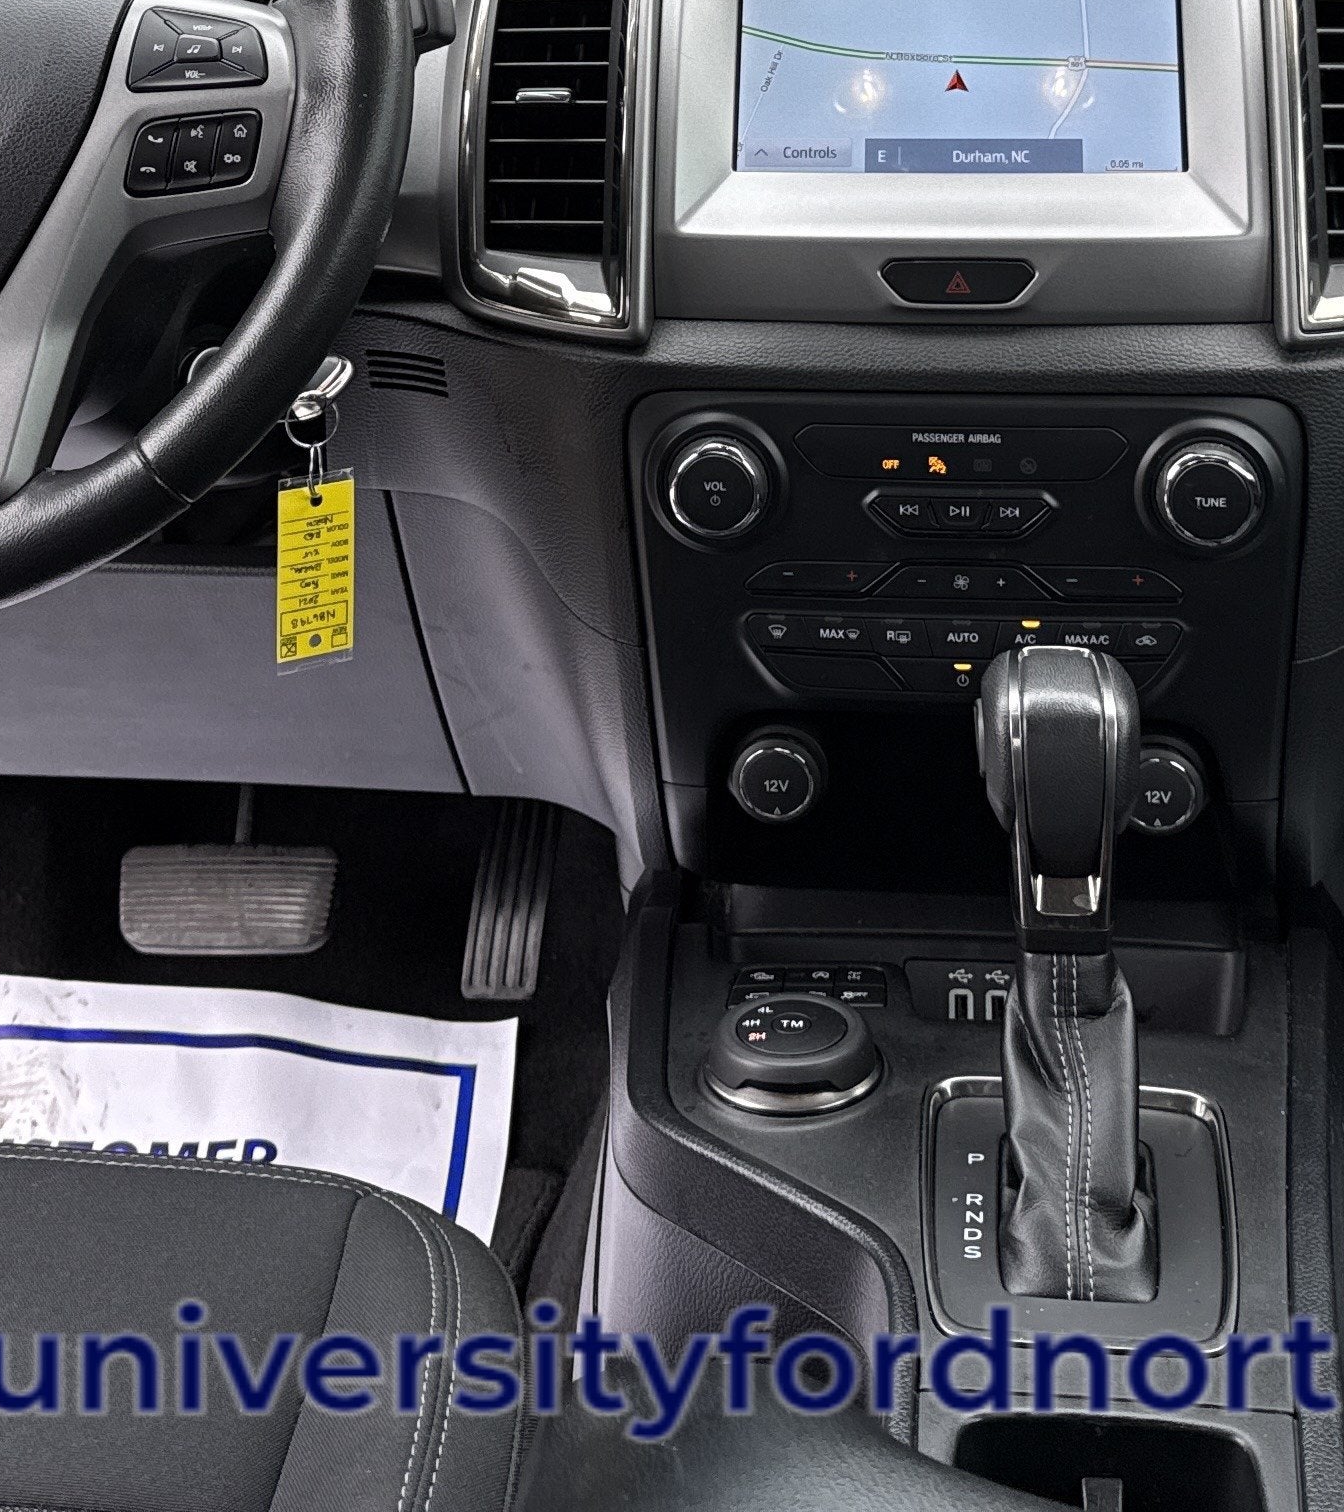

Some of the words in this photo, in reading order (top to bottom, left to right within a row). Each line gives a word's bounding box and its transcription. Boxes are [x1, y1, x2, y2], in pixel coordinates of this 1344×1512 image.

[760, 74, 774, 93] Oak
[783, 145, 837, 159] Controls
[877, 150, 886, 163] E
[952, 149, 1008, 165] Durham,
[1011, 150, 1030, 163] NC
[912, 432, 965, 444] PASSENGER
[968, 432, 1002, 444] AIRBAG
[882, 459, 900, 470] OFF
[704, 481, 726, 492] VOL
[1195, 497, 1227, 509] TUNE
[819, 628, 845, 640] MAX
[886, 630, 896, 641] R
[946, 632, 979, 644] AUTO
[1014, 633, 1037, 645] A/C
[763, 780, 790, 793] 12V
[1143, 791, 1172, 804] 12V
[757, 1006, 774, 1014] 4L
[741, 1018, 761, 1027] 4H
[780, 1019, 804, 1029] TM
[747, 1031, 767, 1042] 2H
[967, 1151, 985, 1166] P
[965, 1193, 983, 1206] R
[965, 1210, 984, 1224] N
[964, 1227, 983, 1241] D
[964, 1245, 982, 1259] S
